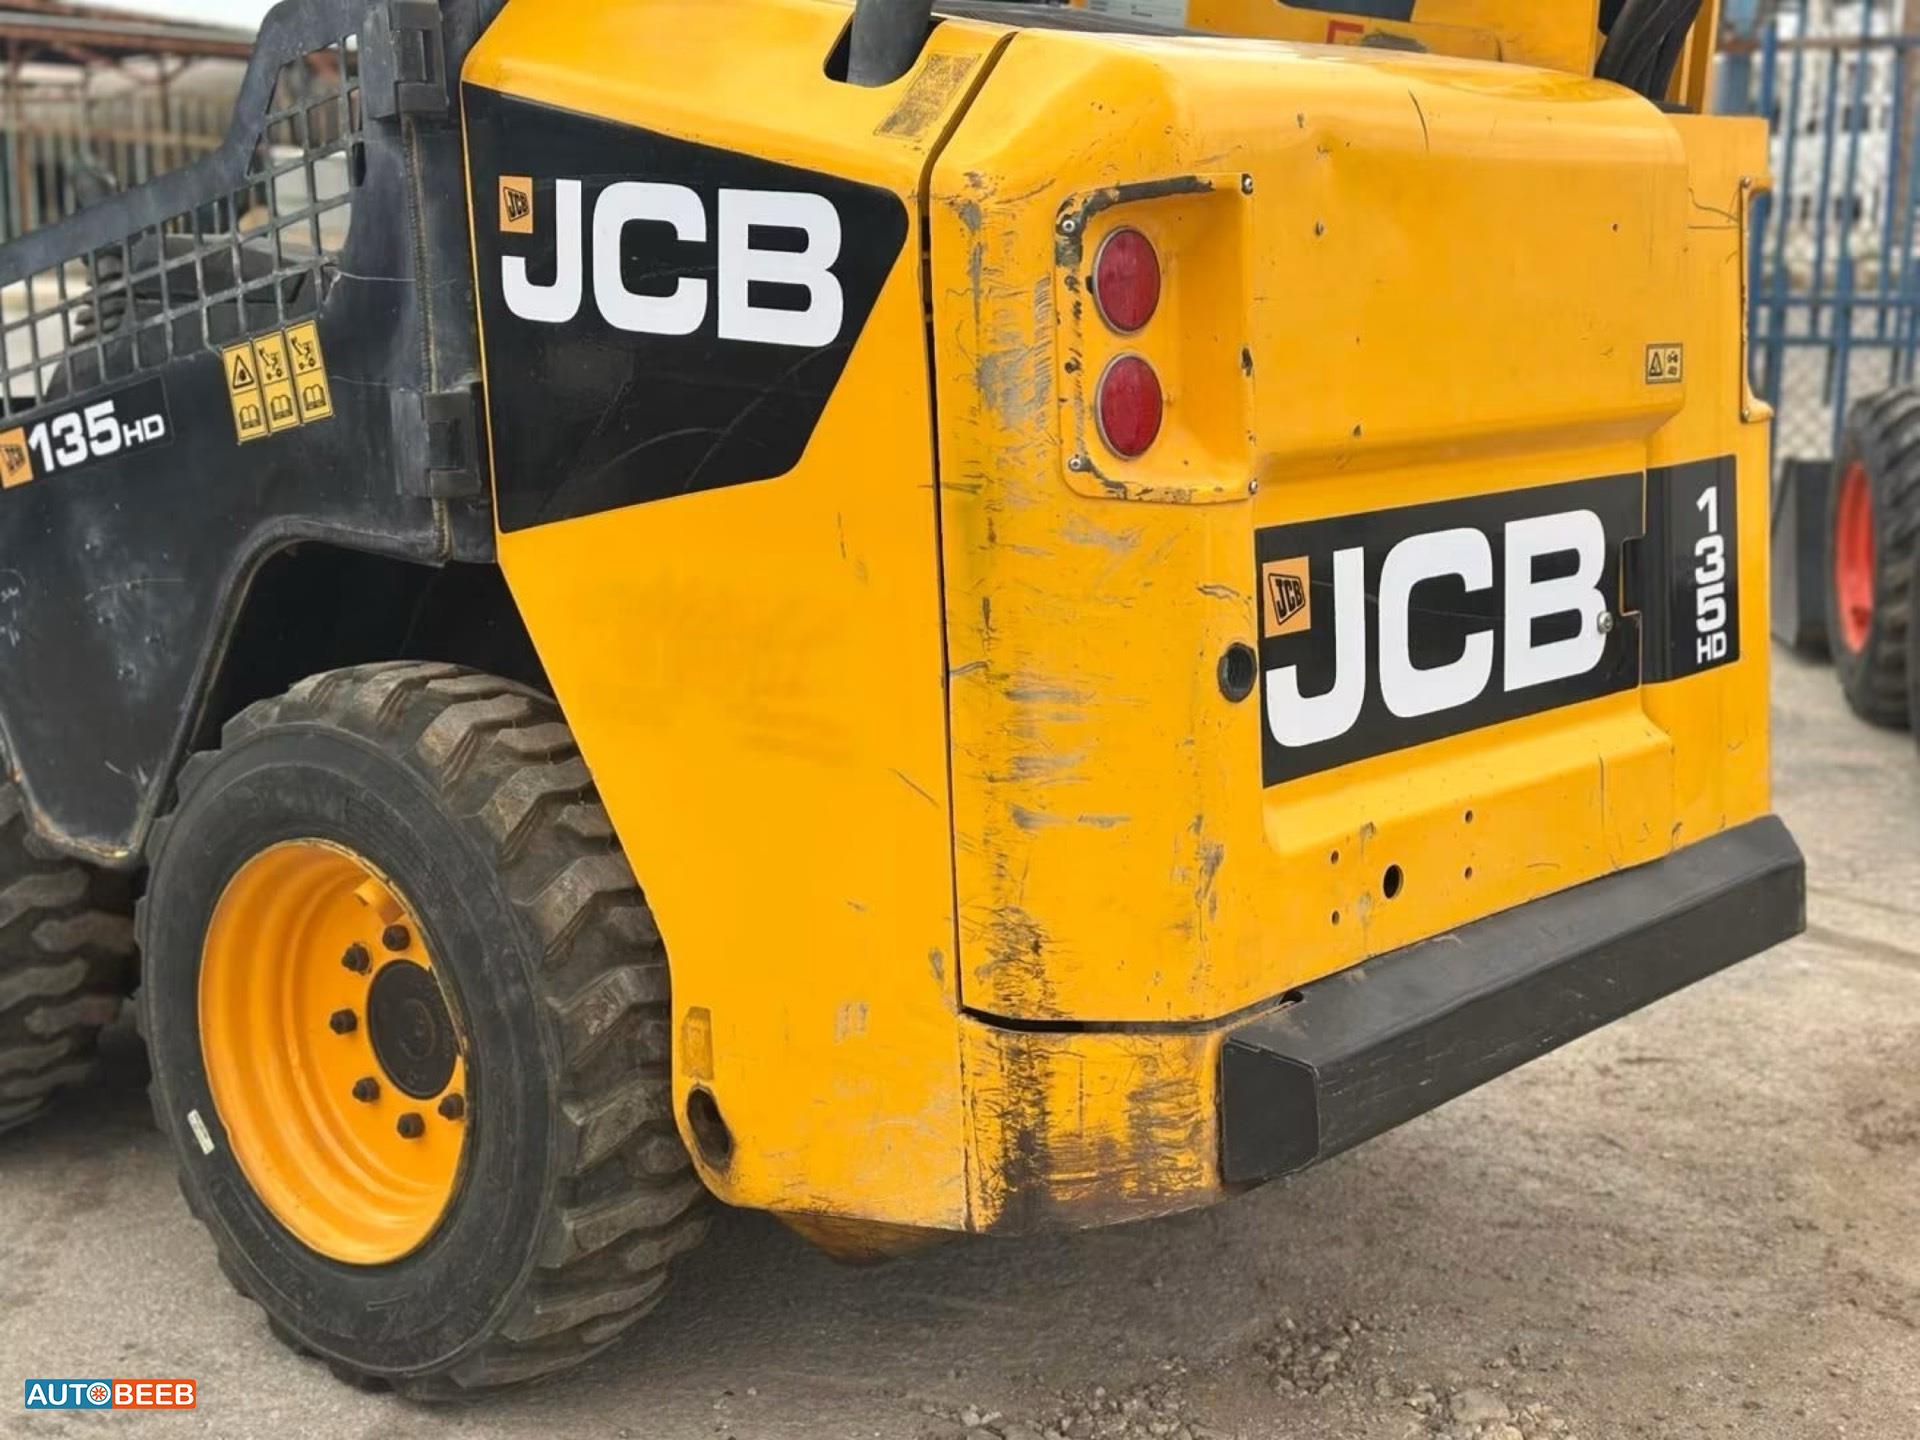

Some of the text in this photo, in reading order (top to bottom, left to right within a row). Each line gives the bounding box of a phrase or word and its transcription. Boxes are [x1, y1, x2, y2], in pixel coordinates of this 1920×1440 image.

[506, 190, 529, 218] JCB
[501, 178, 843, 347] JCB
[1266, 508, 1607, 748] JCB
[1274, 577, 1305, 619] JCB
